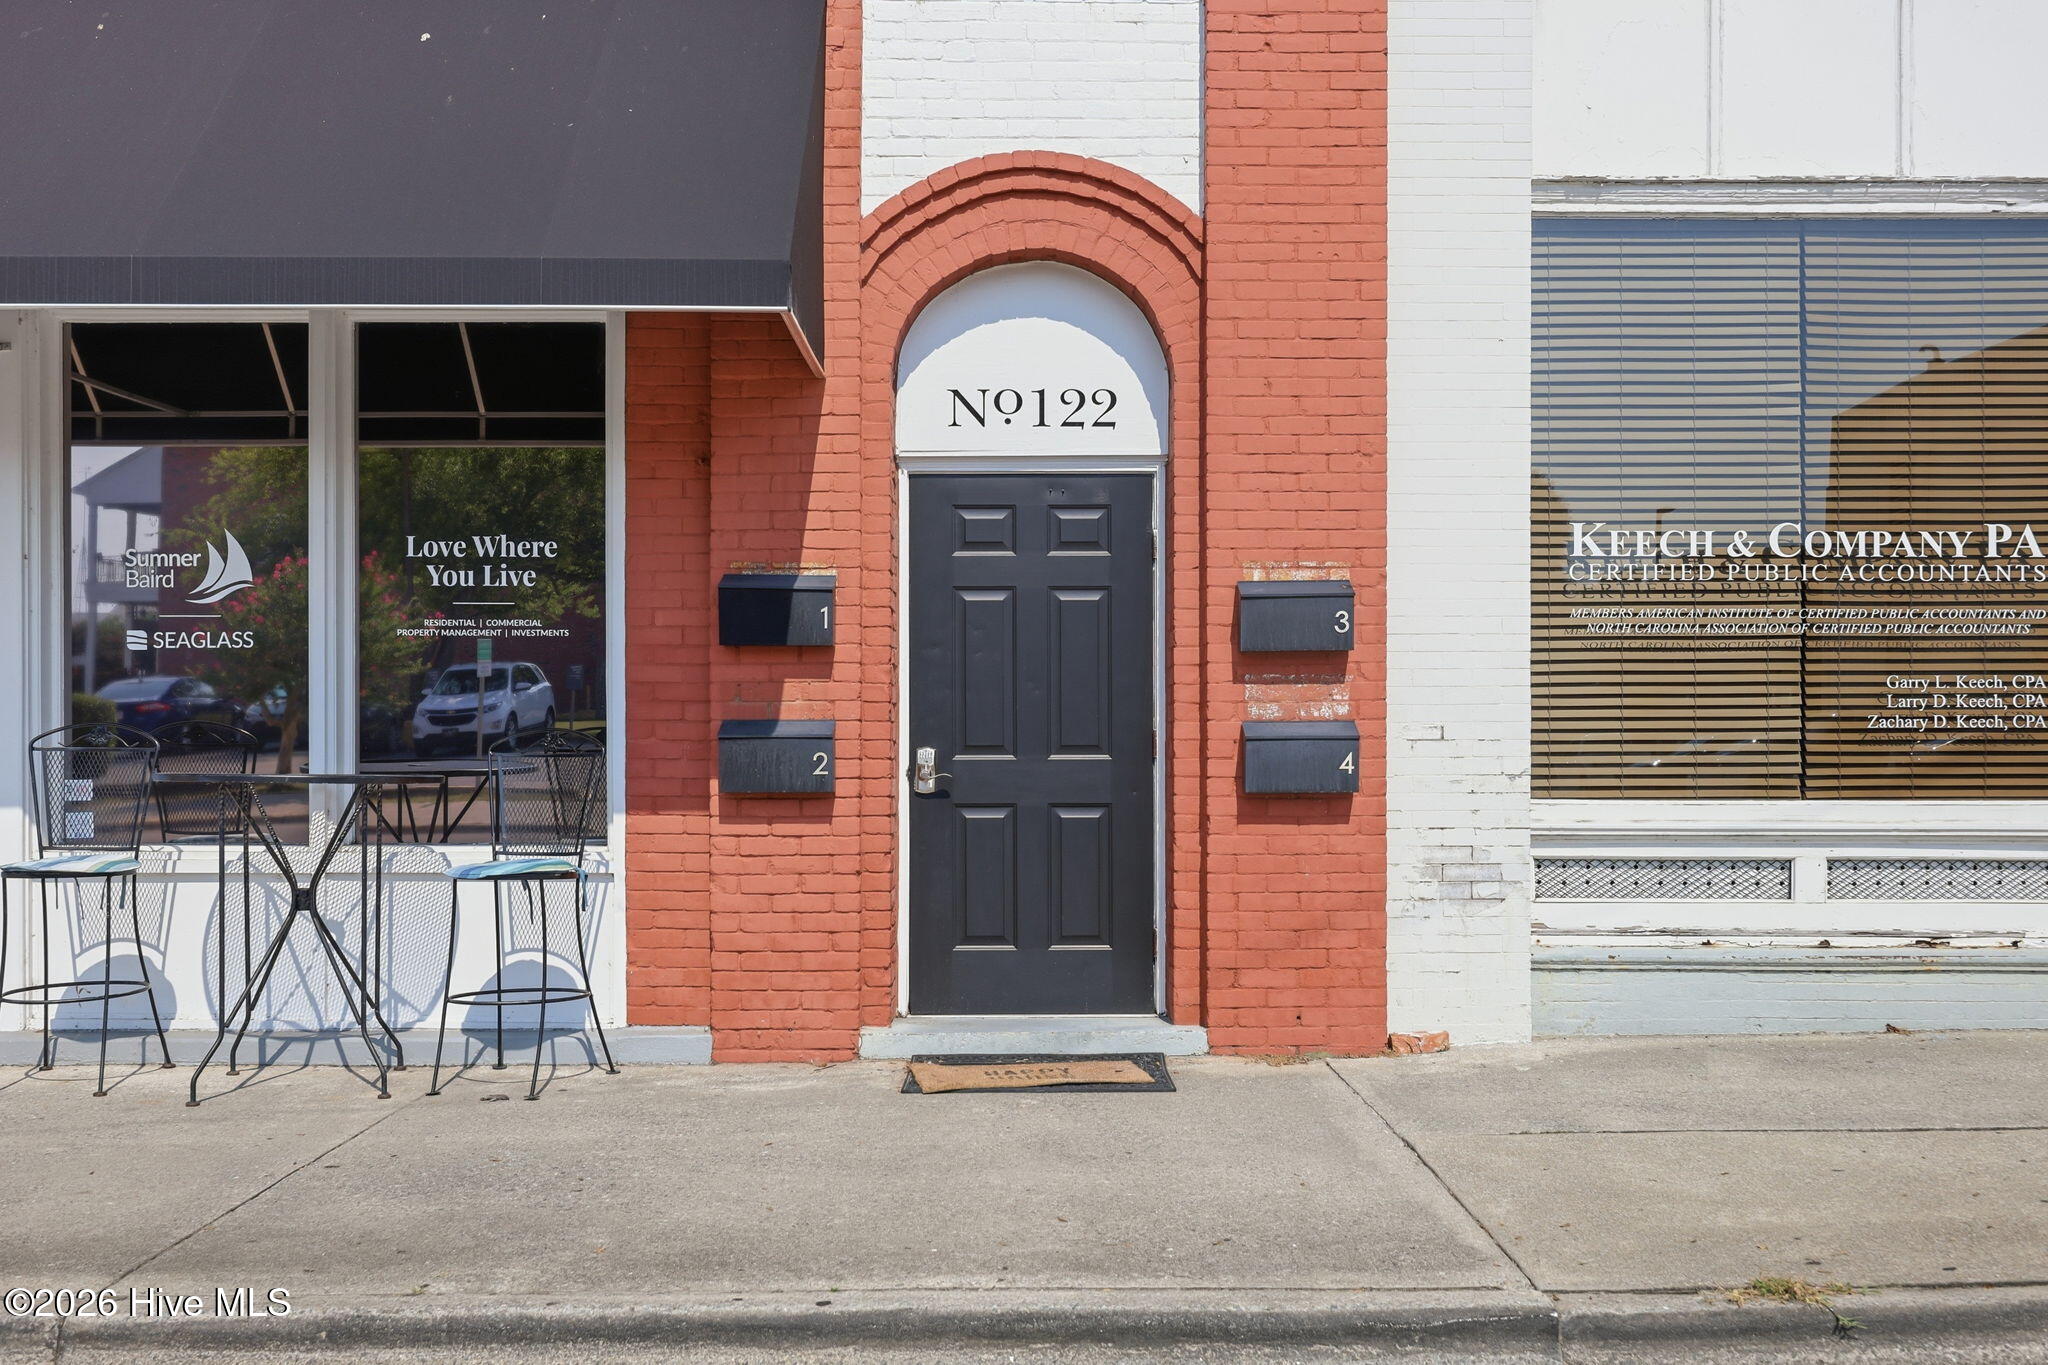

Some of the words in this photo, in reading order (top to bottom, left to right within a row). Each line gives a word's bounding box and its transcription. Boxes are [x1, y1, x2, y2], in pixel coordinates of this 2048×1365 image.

[405, 535, 467, 558] Love
[471, 534, 558, 558] Where
[1569, 522, 1716, 558] KEECH
[1726, 530, 1757, 558] &
[1768, 522, 1973, 558] COMPANY
[1983, 523, 2047, 558] PA
[125, 548, 202, 567] Sumner
[125, 569, 175, 588] Baird
[426, 564, 475, 587] You
[482, 563, 537, 587] Live
[1568, 563, 1716, 582] CERTIFIED
[1727, 563, 1829, 582] PUBLIC
[1838, 563, 2048, 582] ACCOUNTANTS
[423, 618, 477, 627] RESIDENTIAL
[485, 618, 543, 627] COMMERCIAL
[819, 606, 829, 629] 1
[1333, 610, 1350, 634] 3
[1568, 607, 1634, 620] MEMBERS
[1636, 607, 1704, 620] AMERICAN
[1706, 607, 1775, 620] INSTITUTE
[1776, 607, 1796, 620] OF
[1798, 607, 1868, 620] CERTIFIED
[1870, 607, 1921, 620] PUBLIC
[1922, 607, 2017, 620] ACCOUNTANTS
[2017, 607, 2047, 620] AND
[396, 628, 440, 637] PROPERTY
[441, 628, 503, 637] MANAGEMENT
[511, 628, 570, 637] INVESTMENTS
[1585, 622, 1633, 635] NORTH
[1634, 622, 1700, 635] CAROLINA
[1702, 622, 1789, 635] ASSOCIATION
[1790, 622, 1810, 635] OF
[1812, 622, 1883, 635] CERTIFIED
[1884, 622, 1934, 635] PUBLIC
[1935, 622, 2032, 635] ACCOUNTANTS
[152, 631, 254, 649] SEAGLASS
[1886, 674, 1930, 693] Garry
[1934, 674, 1950, 690] L.
[1956, 674, 2008, 692] Keech,
[2012, 674, 2047, 690] CPA
[1886, 694, 1928, 712] Larry
[1933, 694, 1951, 709] D.
[1956, 693, 2008, 712] Keech,
[2012, 693, 2047, 709] CPA
[1866, 714, 1929, 732] Zachary
[1933, 714, 1951, 729] D.
[1956, 714, 2008, 732] Keech,
[2012, 714, 2047, 730] CPA
[812, 751, 829, 775] 2
[1338, 751, 1355, 775] 4
